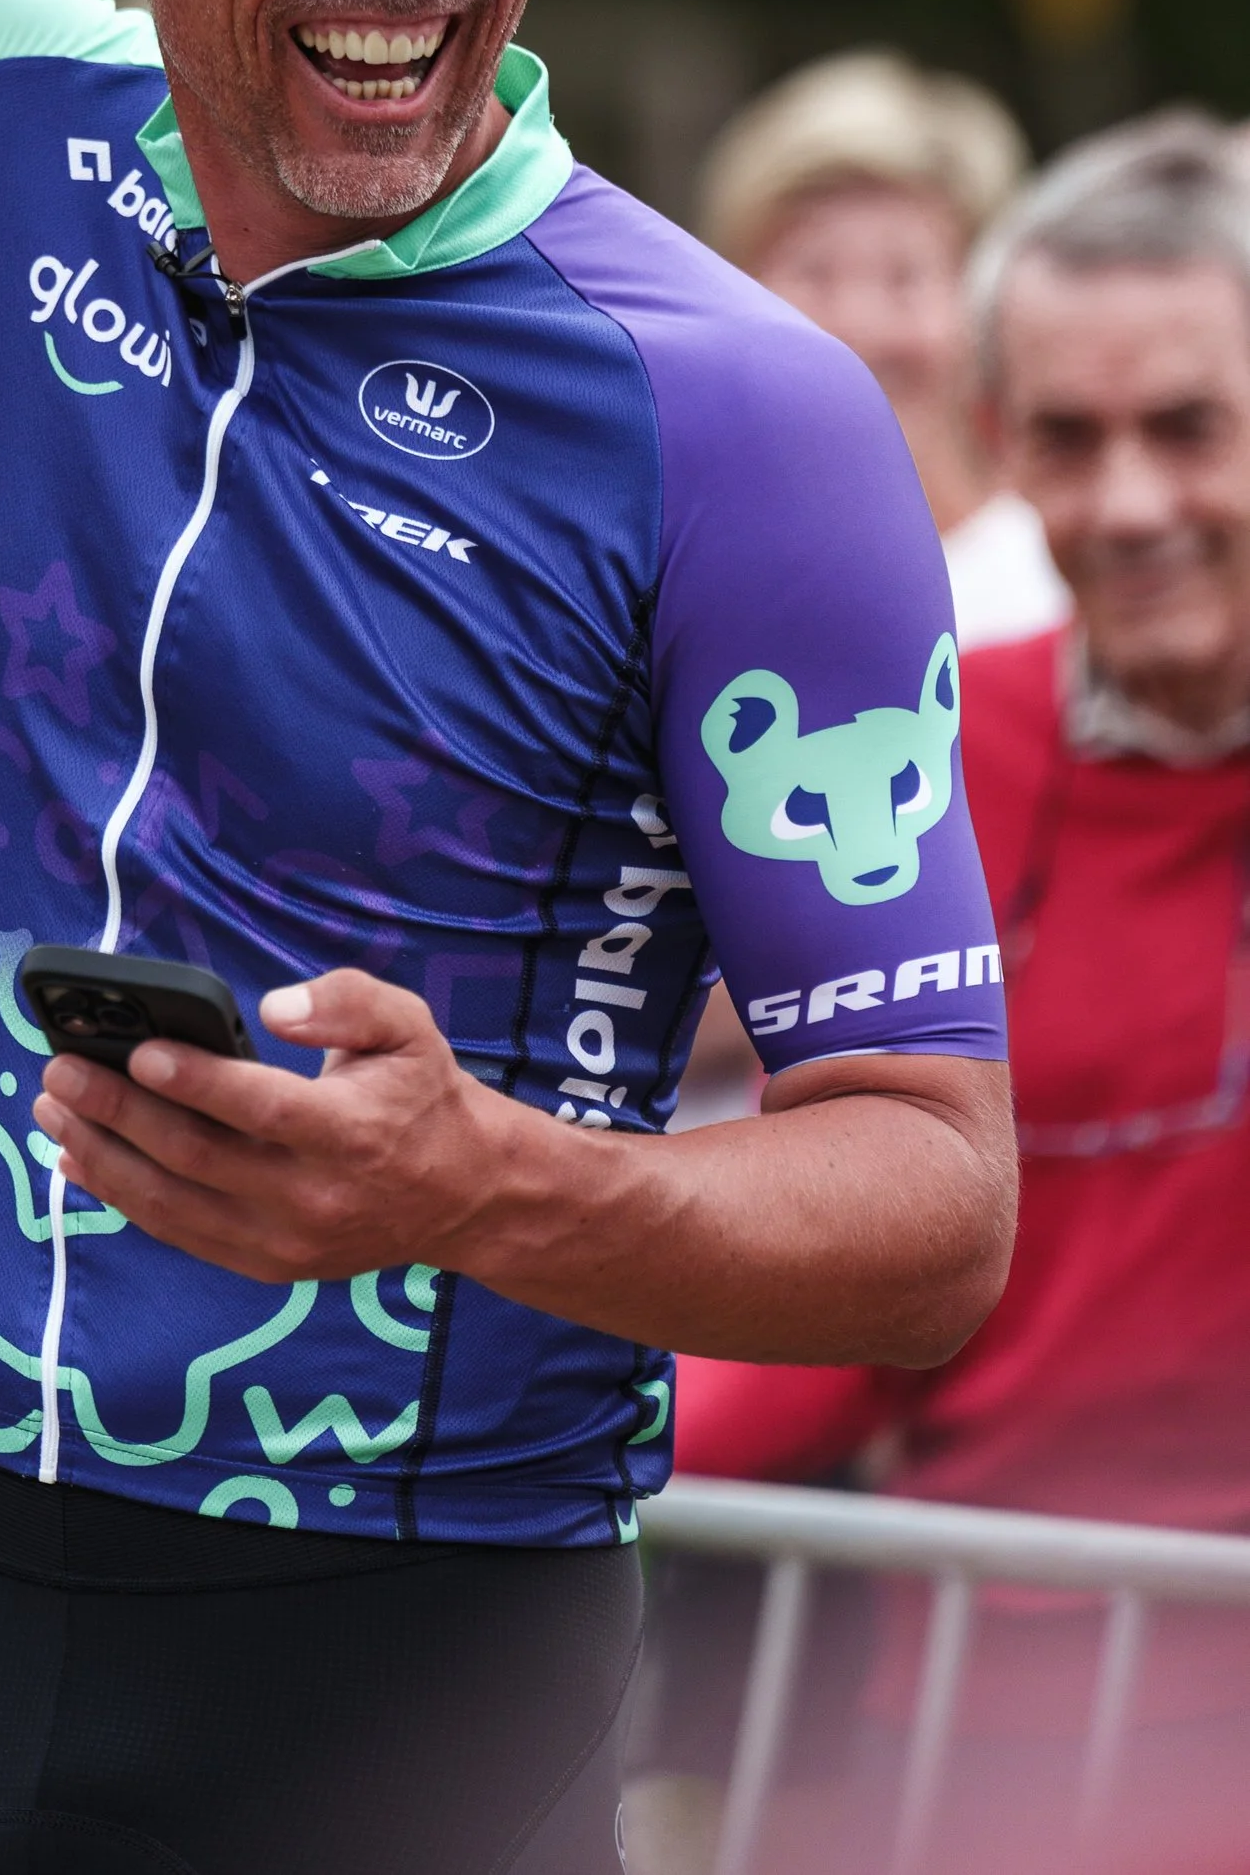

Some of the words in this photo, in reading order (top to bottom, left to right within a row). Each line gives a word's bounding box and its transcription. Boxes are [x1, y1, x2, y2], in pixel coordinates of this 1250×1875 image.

[29, 255, 172, 388] glowi
[374, 406, 467, 449] vermarc
[310, 458, 478, 564] REK
[748, 944, 1005, 1036] SRAM
